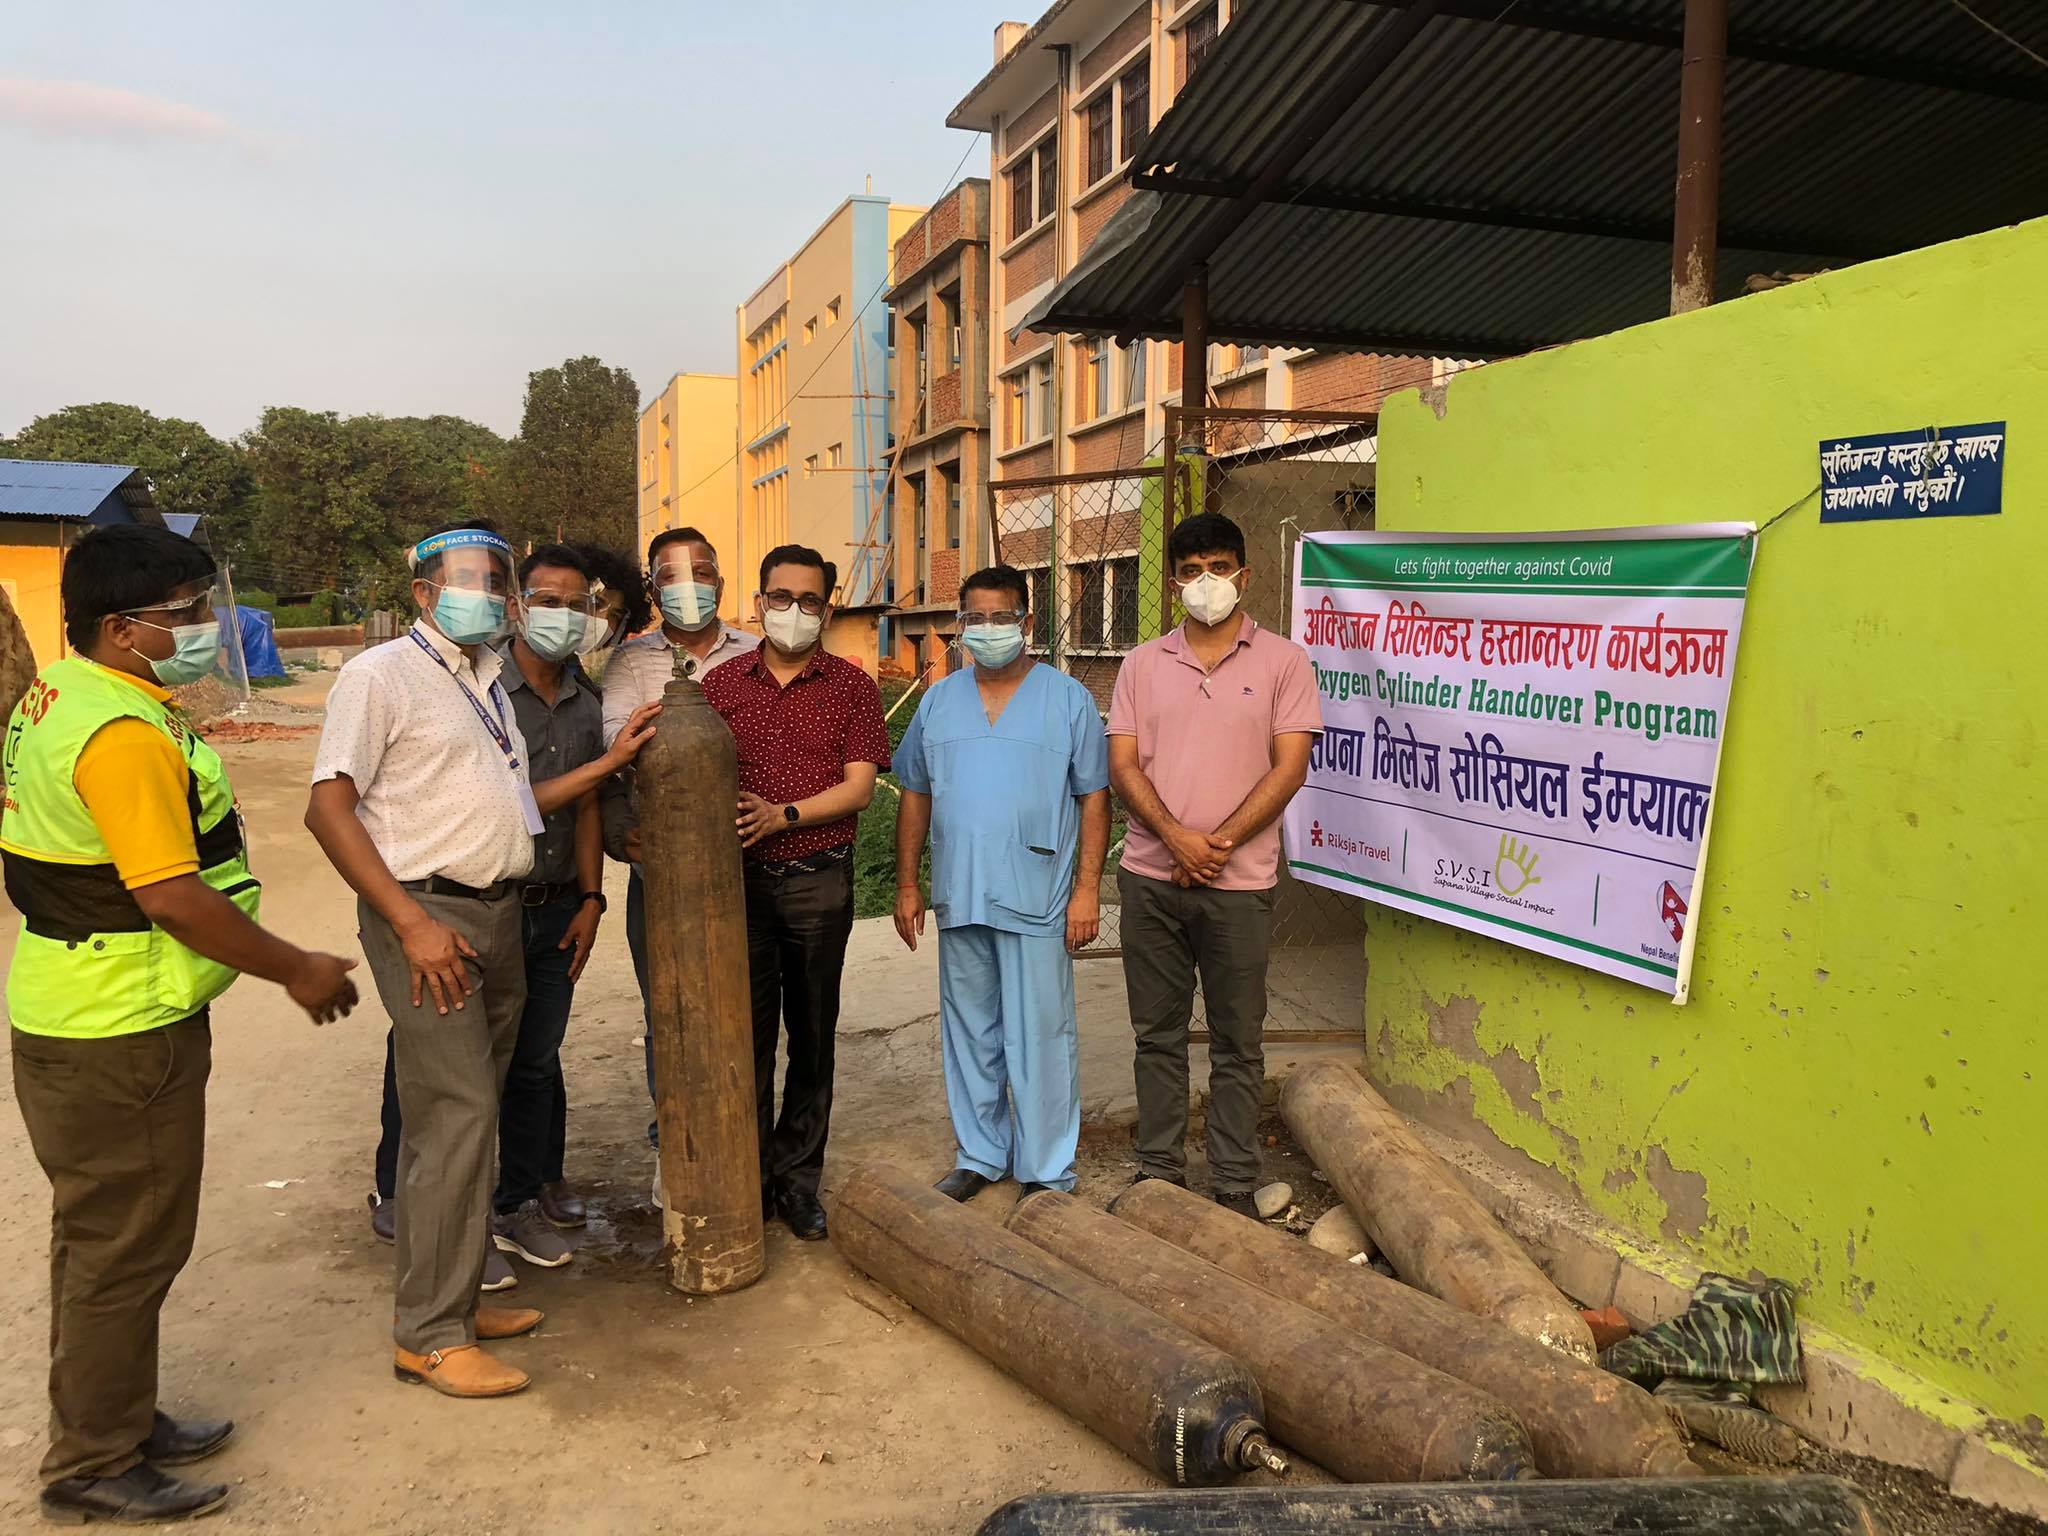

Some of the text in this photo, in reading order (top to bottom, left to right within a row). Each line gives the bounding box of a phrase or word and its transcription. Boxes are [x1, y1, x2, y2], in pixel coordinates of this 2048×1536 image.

[1954, 435, 2003, 464] खाएर
[447, 535, 470, 546] FACE
[1394, 555, 1612, 581] Lets fight together against Covid
[1303, 595, 1728, 679] अक्सिजन सिलिन्डर हस्तान्तरण कार्यक्रम
[1376, 669, 1462, 708] Cylinder
[1468, 678, 1583, 725] Handover
[1594, 691, 1717, 740] Program
[1372, 716, 1440, 793] भिलेज
[1450, 732, 1570, 818] सोसियल
[1327, 832, 1391, 863] Riksja Travel
[1433, 876, 1555, 915] Sapana Village Social Impact
[1641, 943, 1657, 957] Nepal
